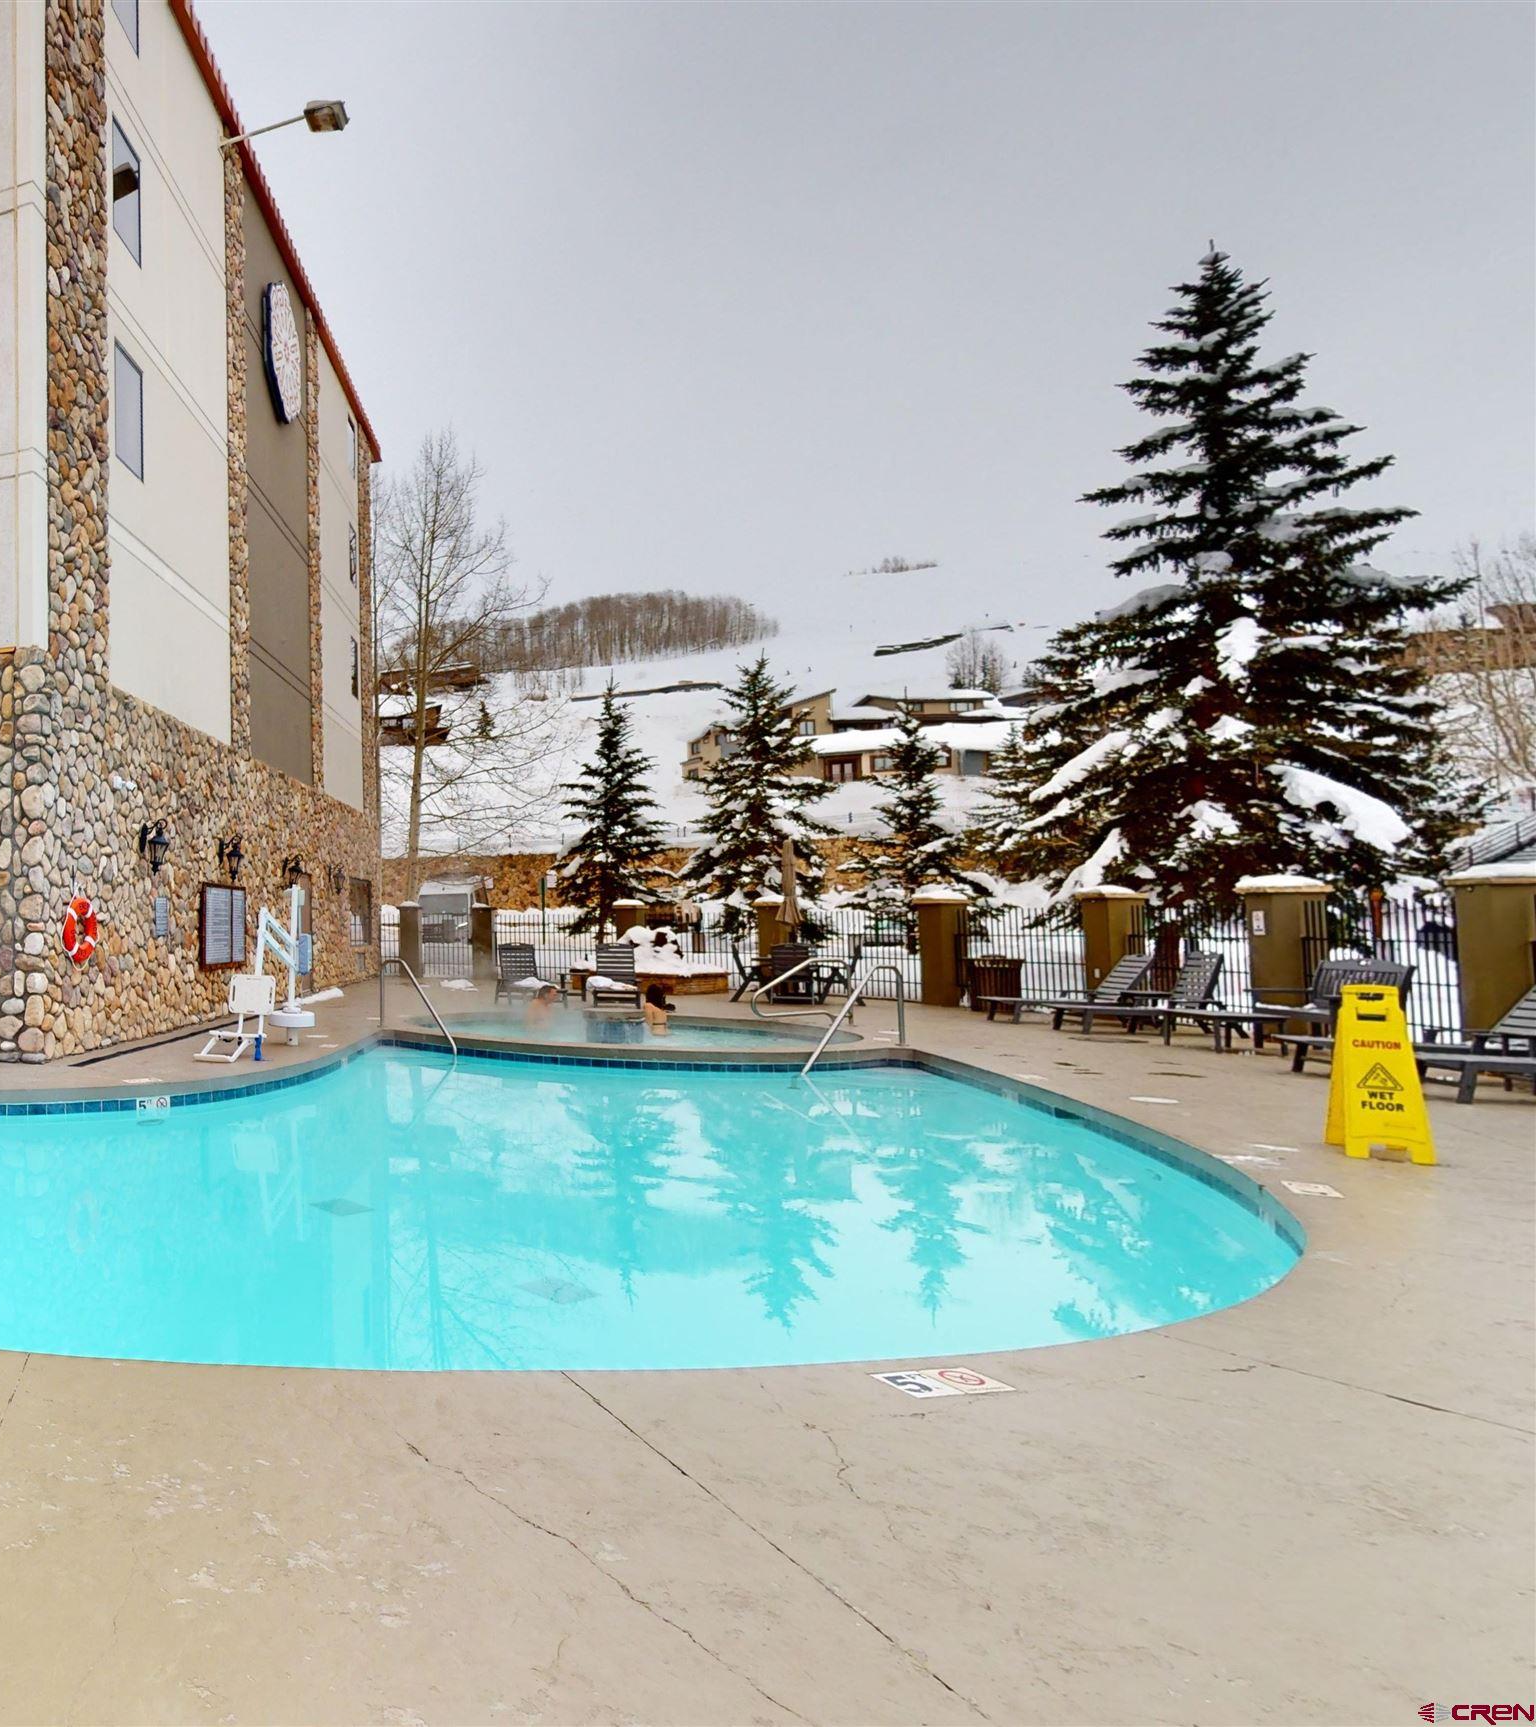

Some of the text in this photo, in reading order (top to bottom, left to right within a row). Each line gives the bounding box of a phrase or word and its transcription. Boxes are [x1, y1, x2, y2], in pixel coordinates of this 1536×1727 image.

[1352, 1039, 1401, 1050] CAUTION
[1367, 1091, 1394, 1100] WET
[1361, 1100, 1405, 1112] FLOOR
[882, 1375, 933, 1393] 5
